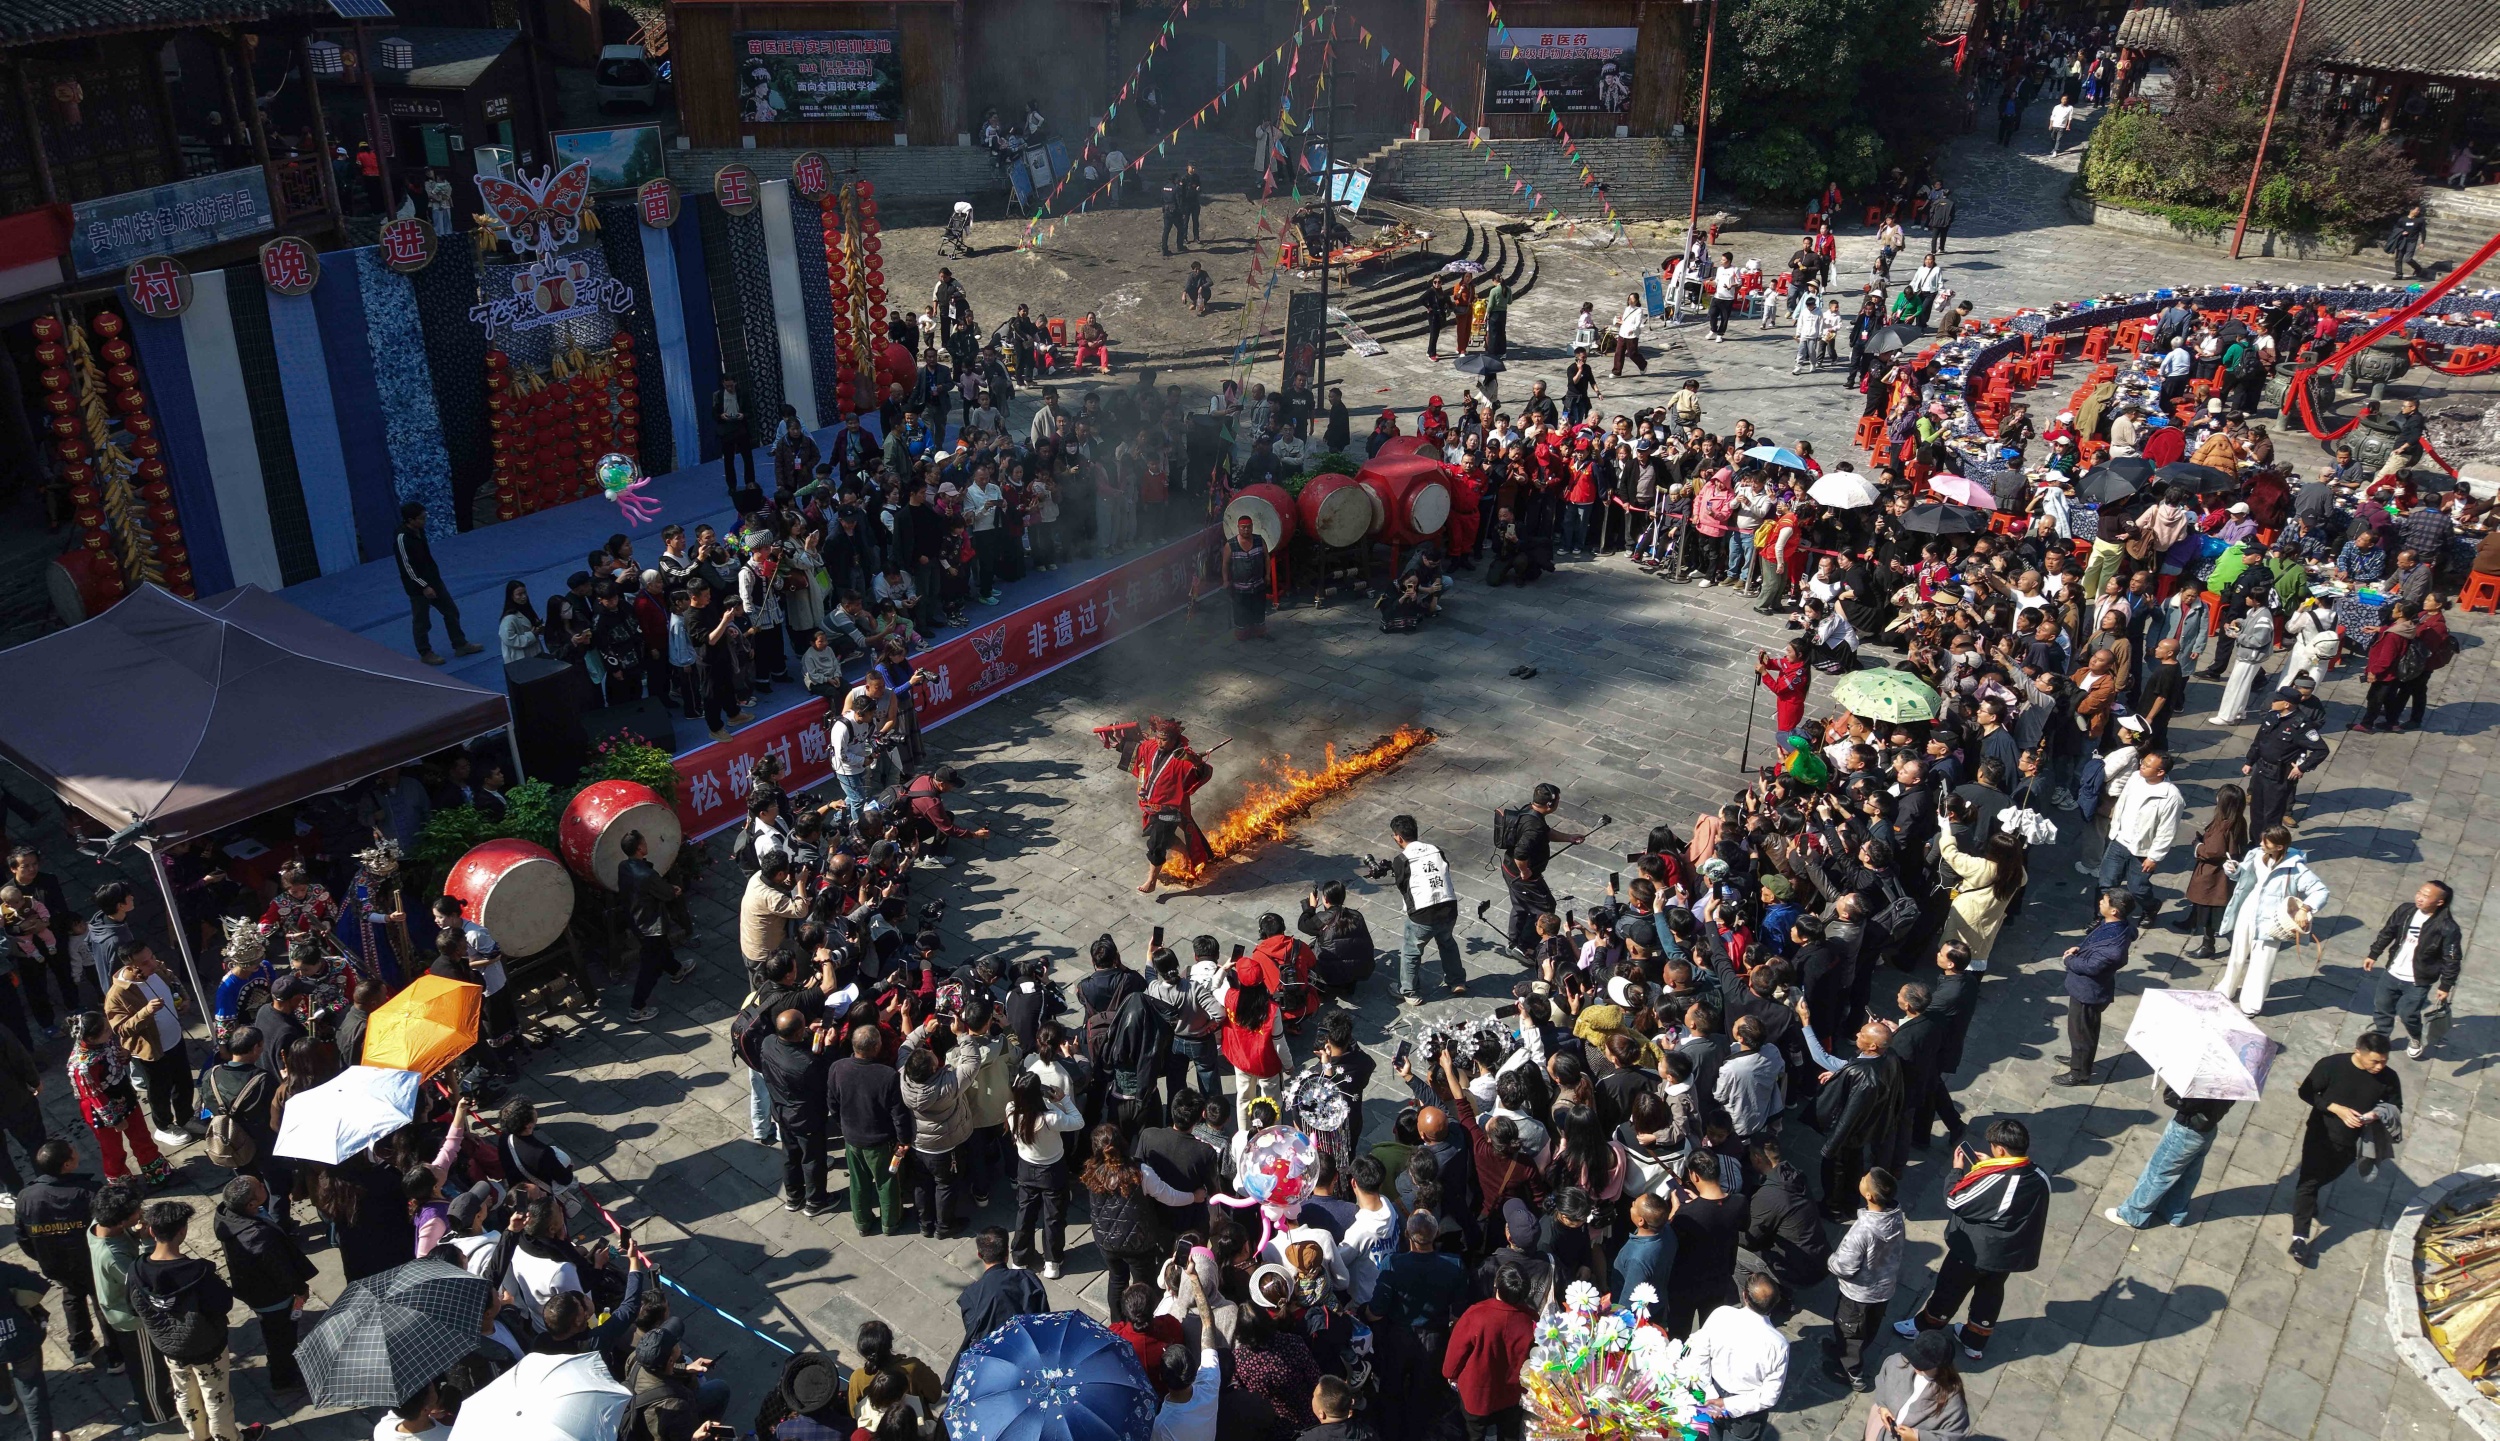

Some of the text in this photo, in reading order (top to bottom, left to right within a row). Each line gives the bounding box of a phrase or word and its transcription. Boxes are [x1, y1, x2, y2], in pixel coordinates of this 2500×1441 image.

[747, 38, 892, 55] 苗医正骨实习培训基地
[1540, 33, 1588, 46] 苗医药
[1499, 47, 1623, 60] 国家级非物质文化遗产
[796, 81, 877, 92] 面向全国招收学徒
[87, 188, 256, 254] 贵州特色旅游商品
[131, 260, 181, 314] 村
[265, 242, 312, 289] 晚
[384, 219, 427, 264] 进
[642, 182, 671, 223] 苗
[721, 171, 752, 207] 王
[796, 156, 827, 195] 城
[539, 315, 560, 325] Village
[560, 308, 584, 319] Festival
[584, 305, 598, 314] Gala
[690, 722, 832, 815] 松桃村晚
